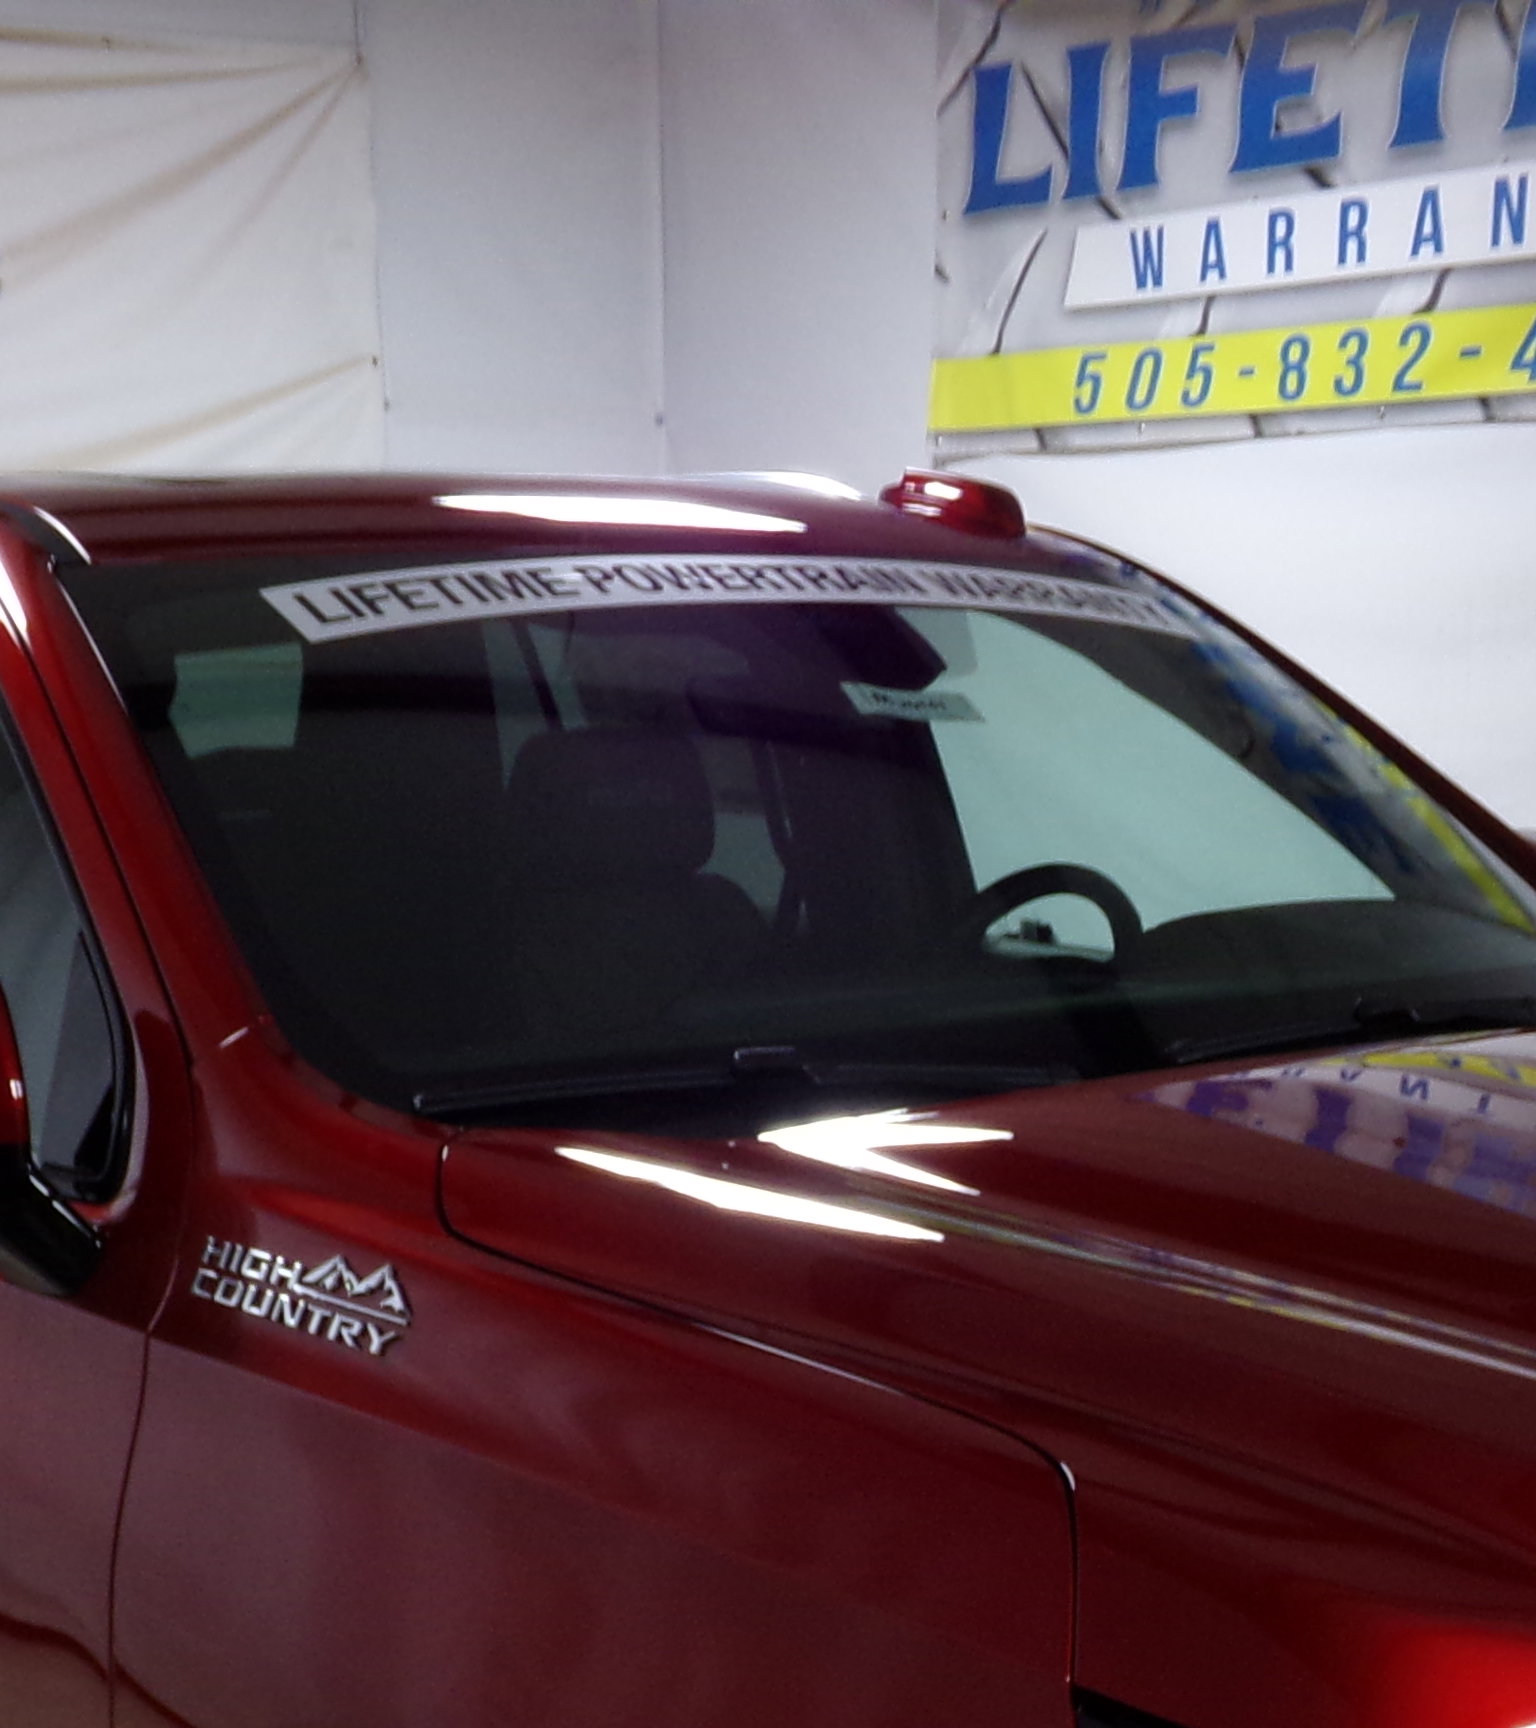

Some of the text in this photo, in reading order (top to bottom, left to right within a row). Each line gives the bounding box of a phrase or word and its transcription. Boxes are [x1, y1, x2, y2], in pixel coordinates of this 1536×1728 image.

[292, 566, 581, 624] LIFETIME
[571, 561, 927, 597] POWERTRAIN
[201, 1234, 305, 1294] HIGH
[190, 1266, 398, 1356] COUNTRY
